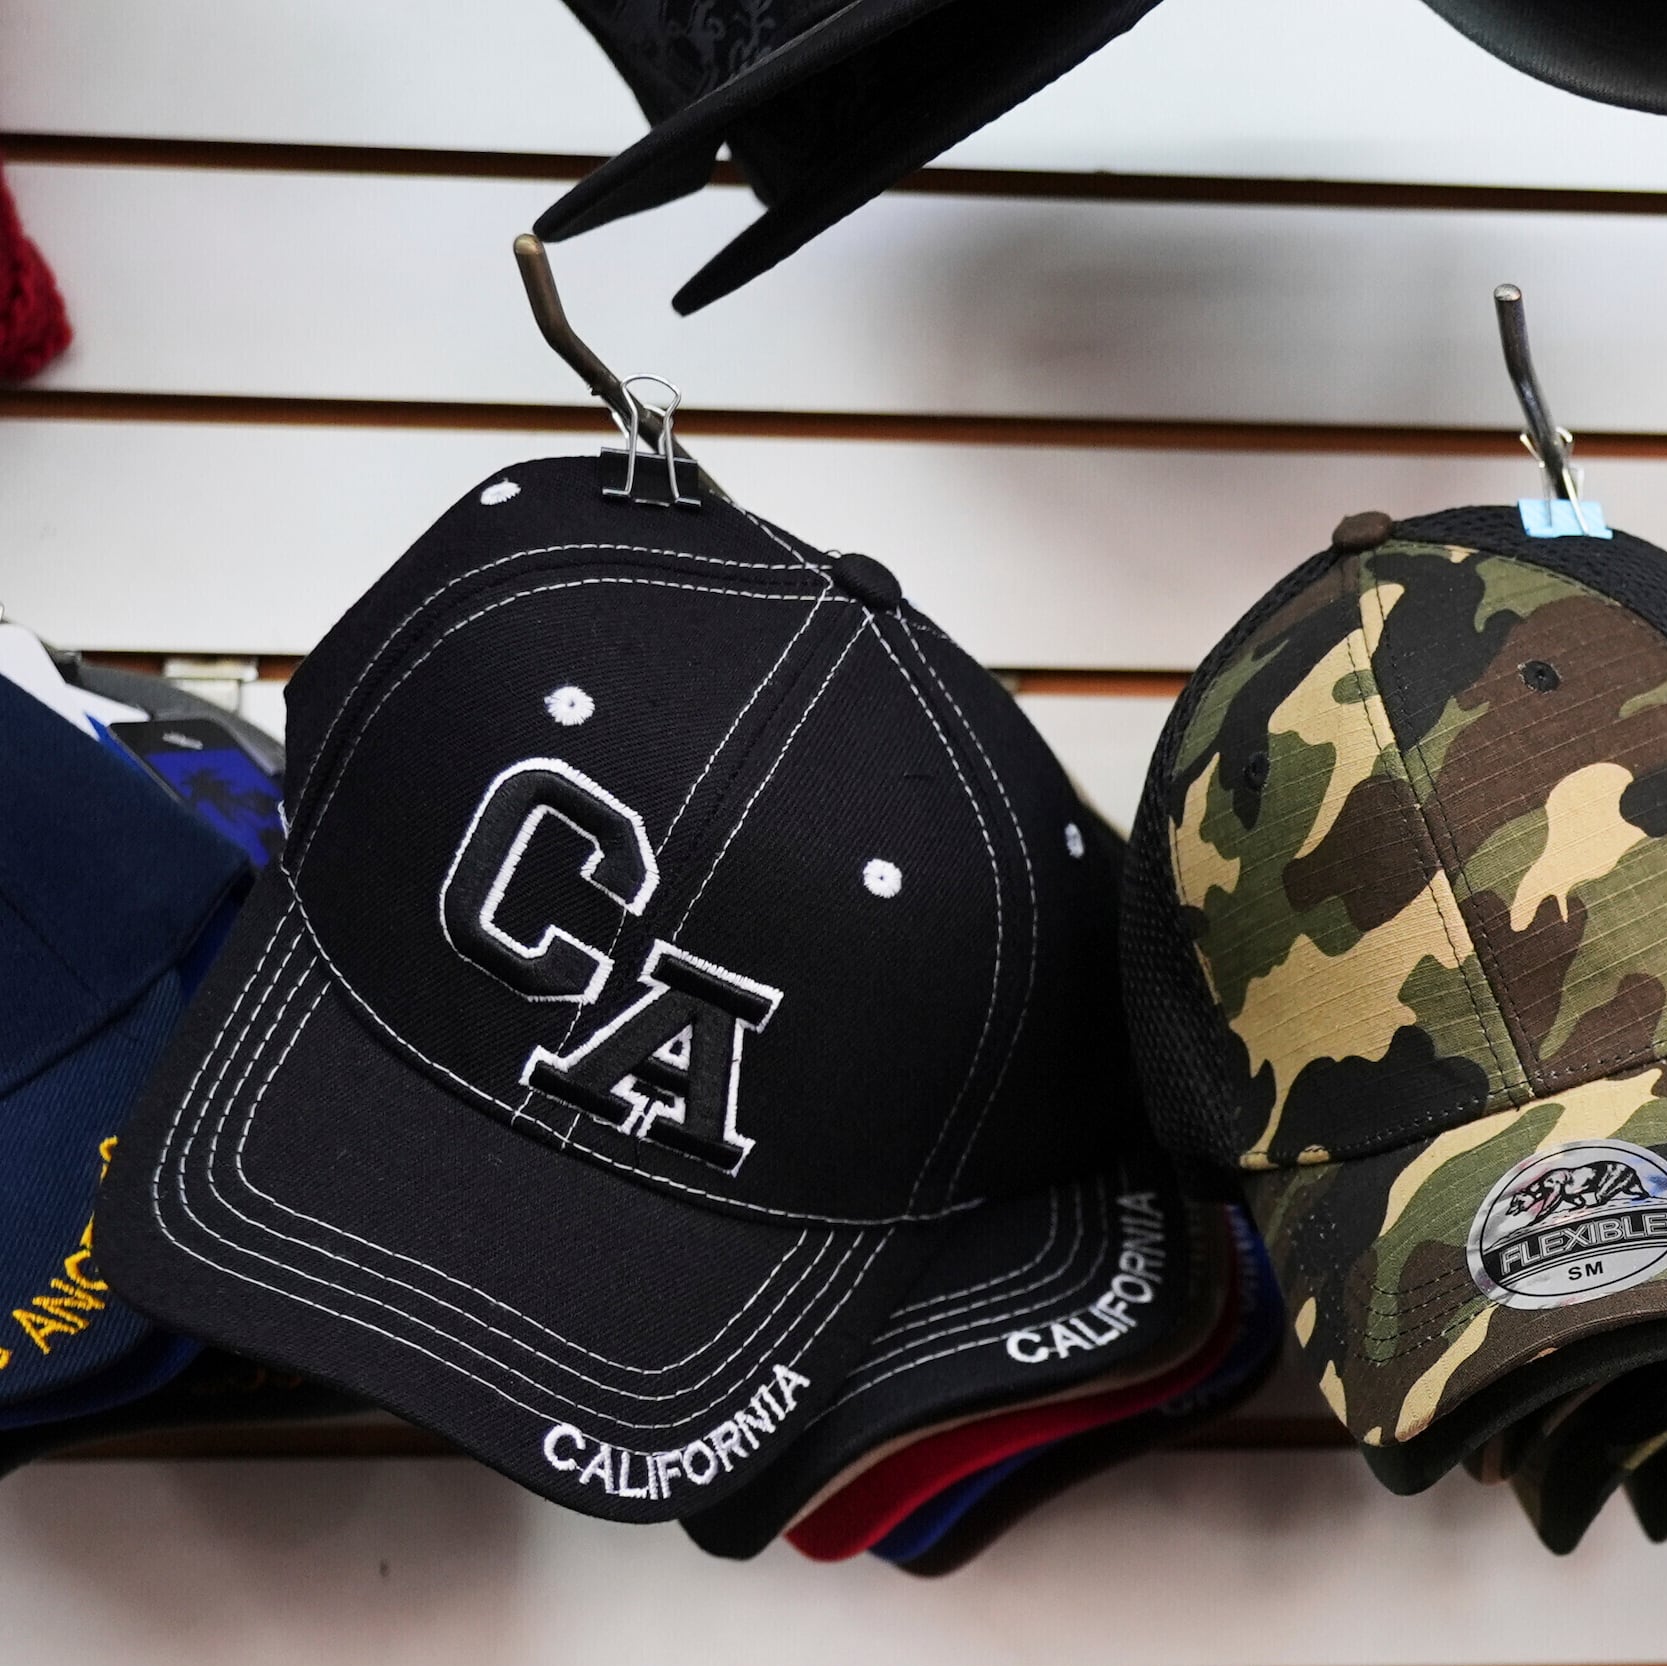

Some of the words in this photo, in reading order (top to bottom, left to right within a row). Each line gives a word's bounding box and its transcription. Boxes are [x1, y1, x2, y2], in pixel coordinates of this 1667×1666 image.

[440, 757, 784, 1177] CA
[1006, 1192, 1166, 1363] CALIFORNIA
[1567, 1260, 1605, 1281] SM
[543, 1363, 811, 1501] CALIFORNIA
